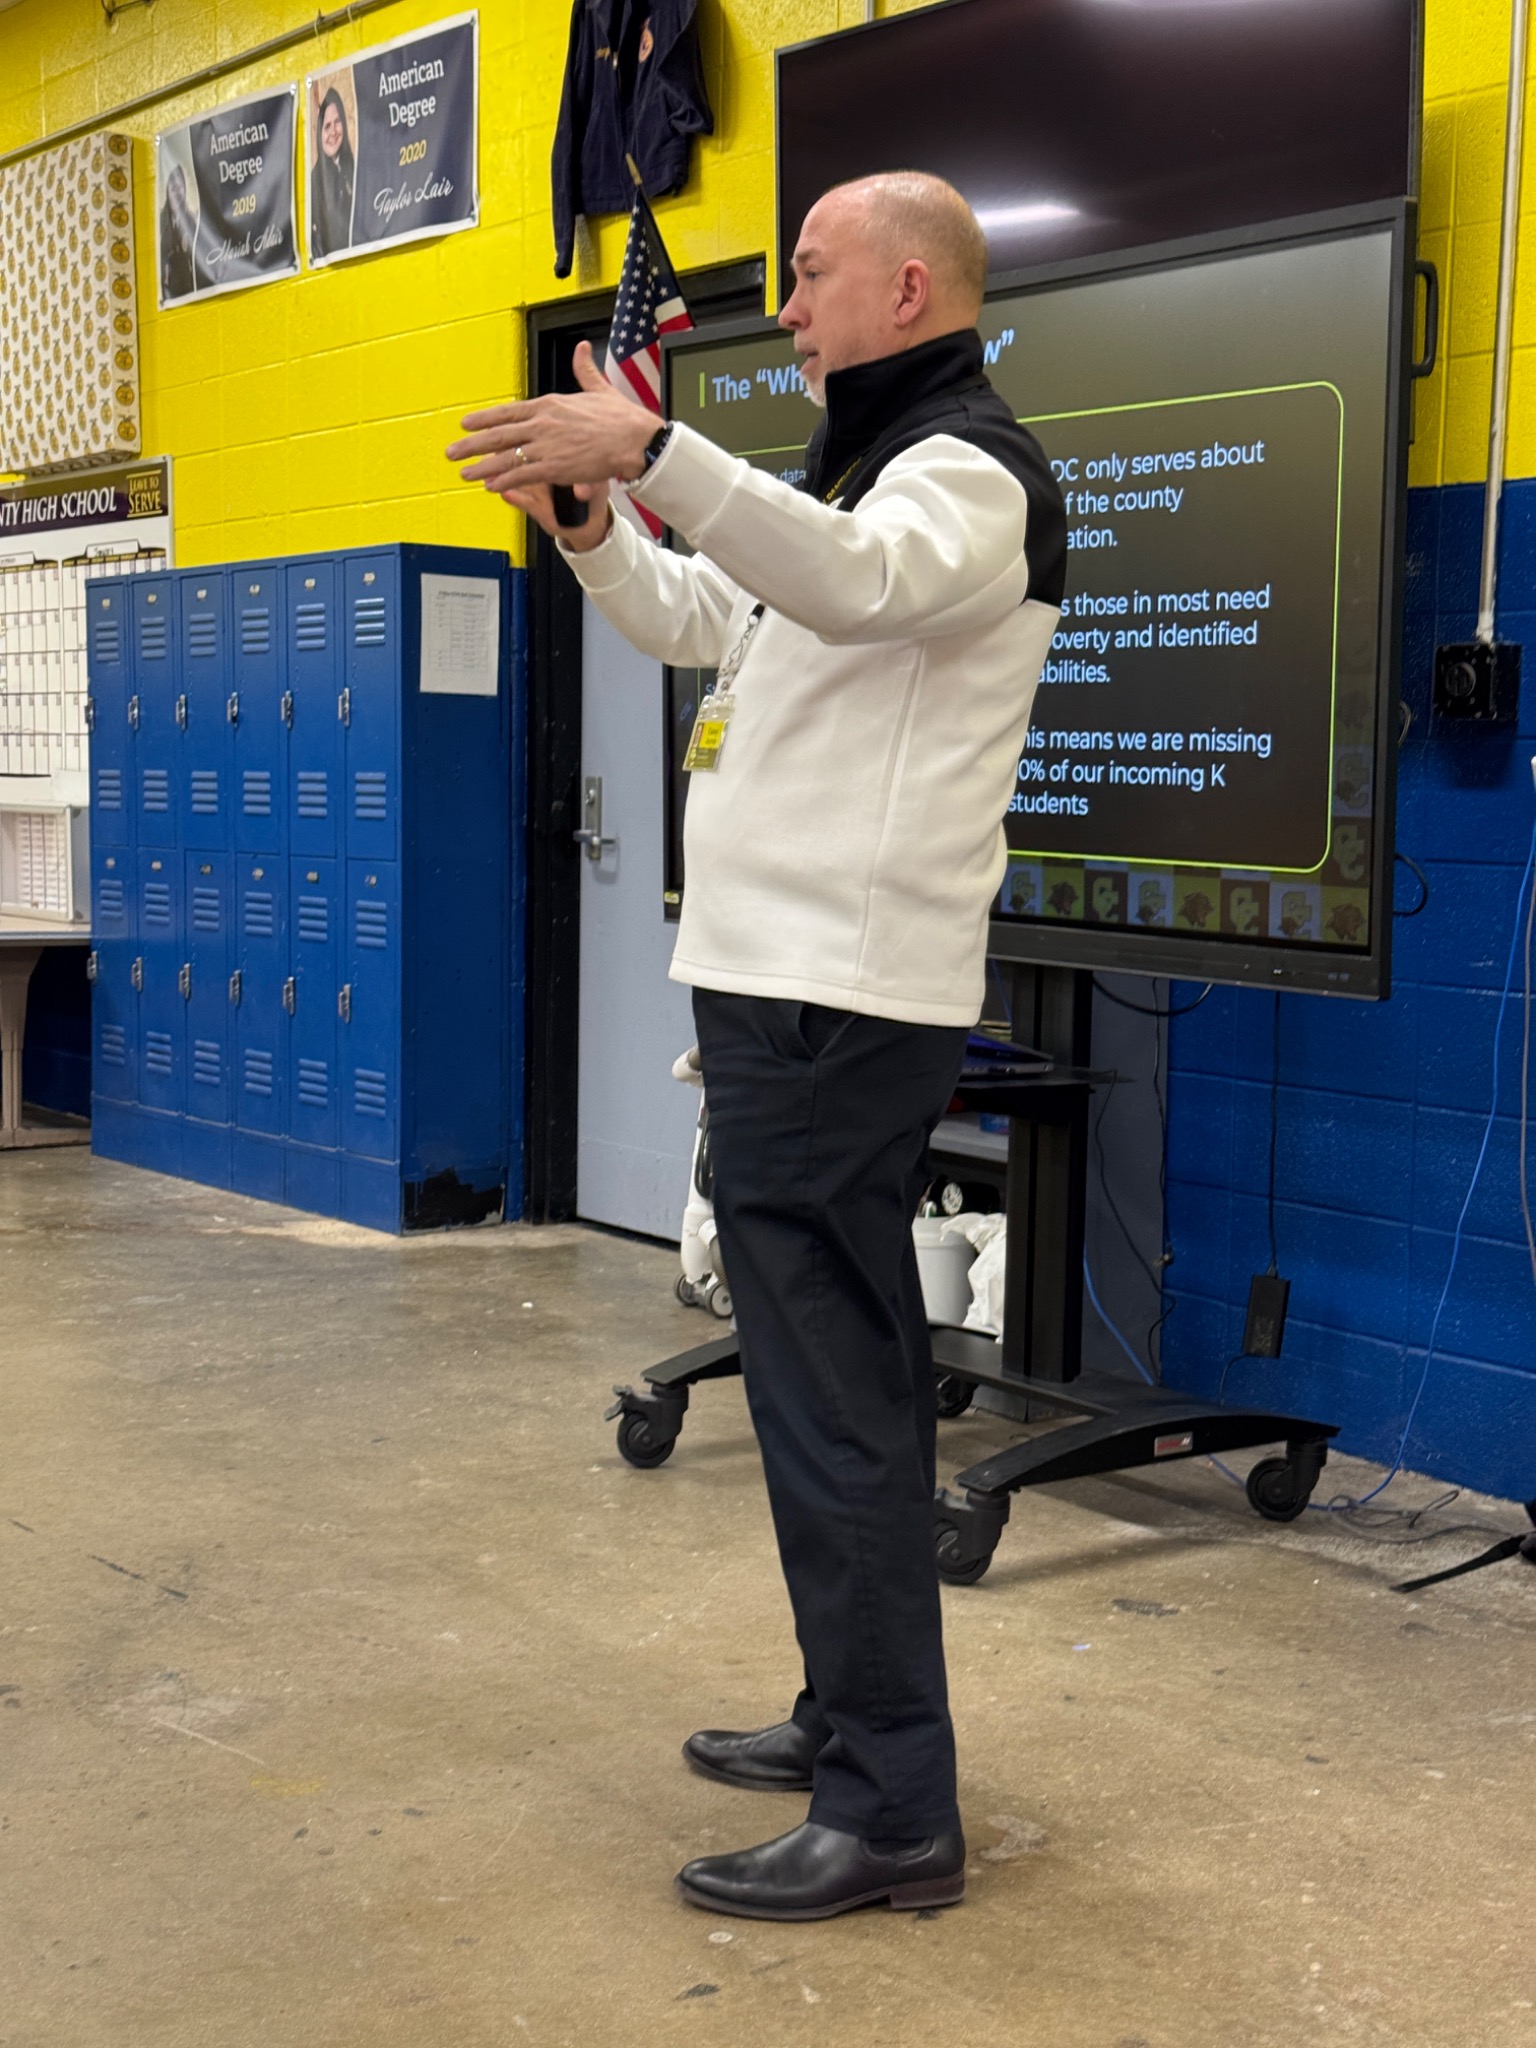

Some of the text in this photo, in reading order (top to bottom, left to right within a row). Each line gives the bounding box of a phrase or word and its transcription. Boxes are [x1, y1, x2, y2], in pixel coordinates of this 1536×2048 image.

[378, 57, 444, 97] American
[389, 95, 436, 128] Degree
[210, 121, 268, 156] American
[399, 139, 427, 166] 2020
[218, 155, 263, 184] Degree
[232, 195, 256, 217] 2019
[373, 171, 454, 223] Taylor Lair
[712, 374, 751, 403] The
[1085, 452, 1128, 483] only
[1131, 448, 1196, 475] serves
[1200, 440, 1265, 468] about
[149, 476, 160, 490] TO
[22, 494, 57, 524] HIGH
[60, 486, 117, 519] SCHOOL
[128, 490, 161, 514] SERVE
[1076, 489, 1109, 514] the
[1114, 485, 1184, 512] county
[1074, 591, 1128, 616] those
[1134, 589, 1152, 614] in
[1157, 588, 1210, 613] most
[1215, 583, 1271, 610] need
[1114, 623, 1153, 649] and
[1158, 620, 1258, 646] identified
[1049, 730, 1114, 750] means
[1117, 732, 1146, 751] we
[1151, 731, 1183, 751] are
[1189, 727, 1272, 758] missing
[1049, 759, 1070, 782] of
[1072, 764, 1105, 783] our
[1109, 760, 1205, 792] incoming
[1211, 763, 1226, 788] K
[1008, 790, 1089, 815] students
